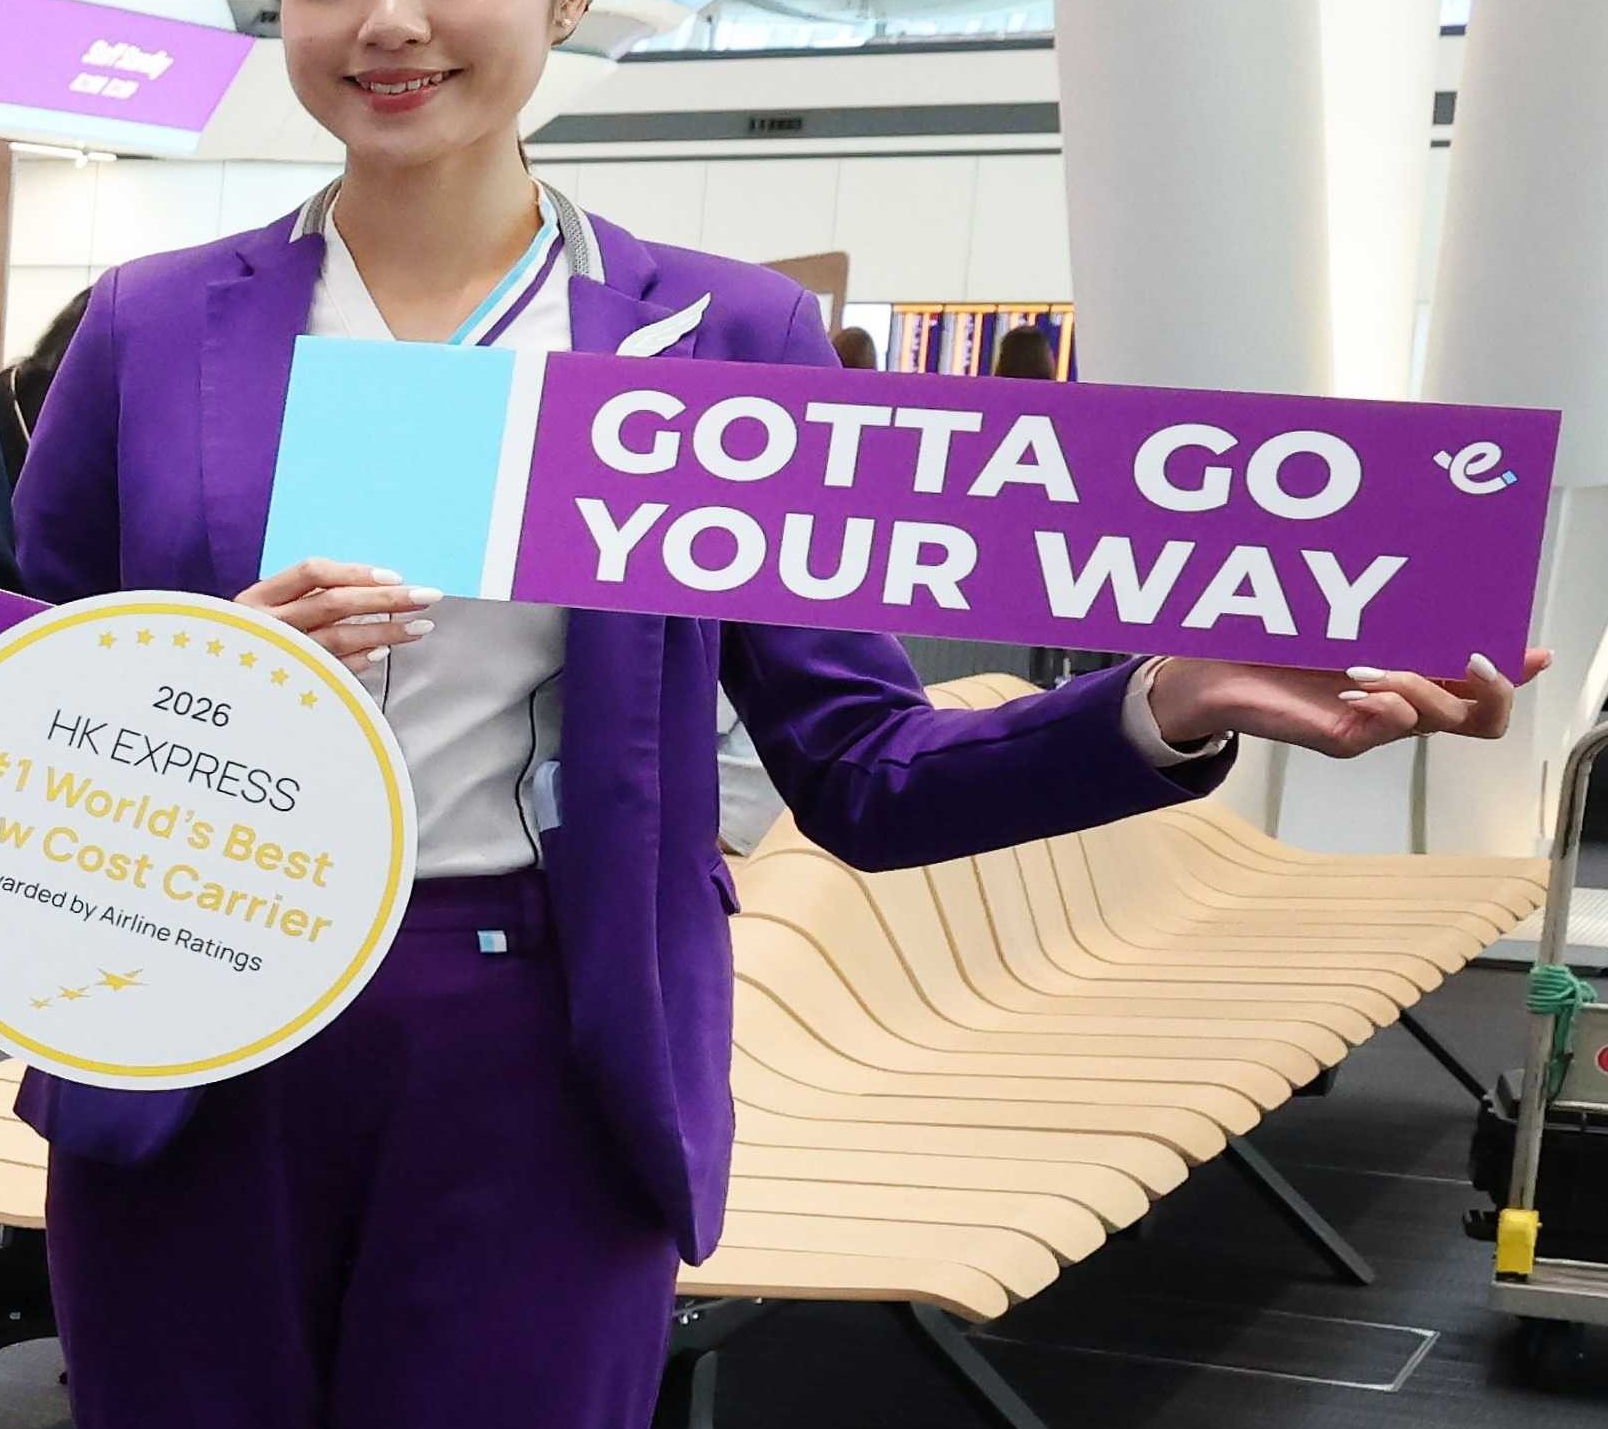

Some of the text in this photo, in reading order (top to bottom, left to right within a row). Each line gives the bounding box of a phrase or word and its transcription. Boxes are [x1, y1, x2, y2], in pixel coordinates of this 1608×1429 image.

[592, 390, 1079, 502] GOTTA
[1134, 424, 1361, 519] GO
[575, 498, 1407, 640] YOUR WAY
[153, 686, 231, 727] 2026
[48, 710, 300, 811] HK EXPRESS
[43, 827, 153, 889] Cost
[164, 865, 331, 942] Carrier
[223, 825, 333, 886] Best
[70, 895, 97, 921] by
[100, 906, 170, 941] Airline
[175, 929, 262, 971] Ratings
